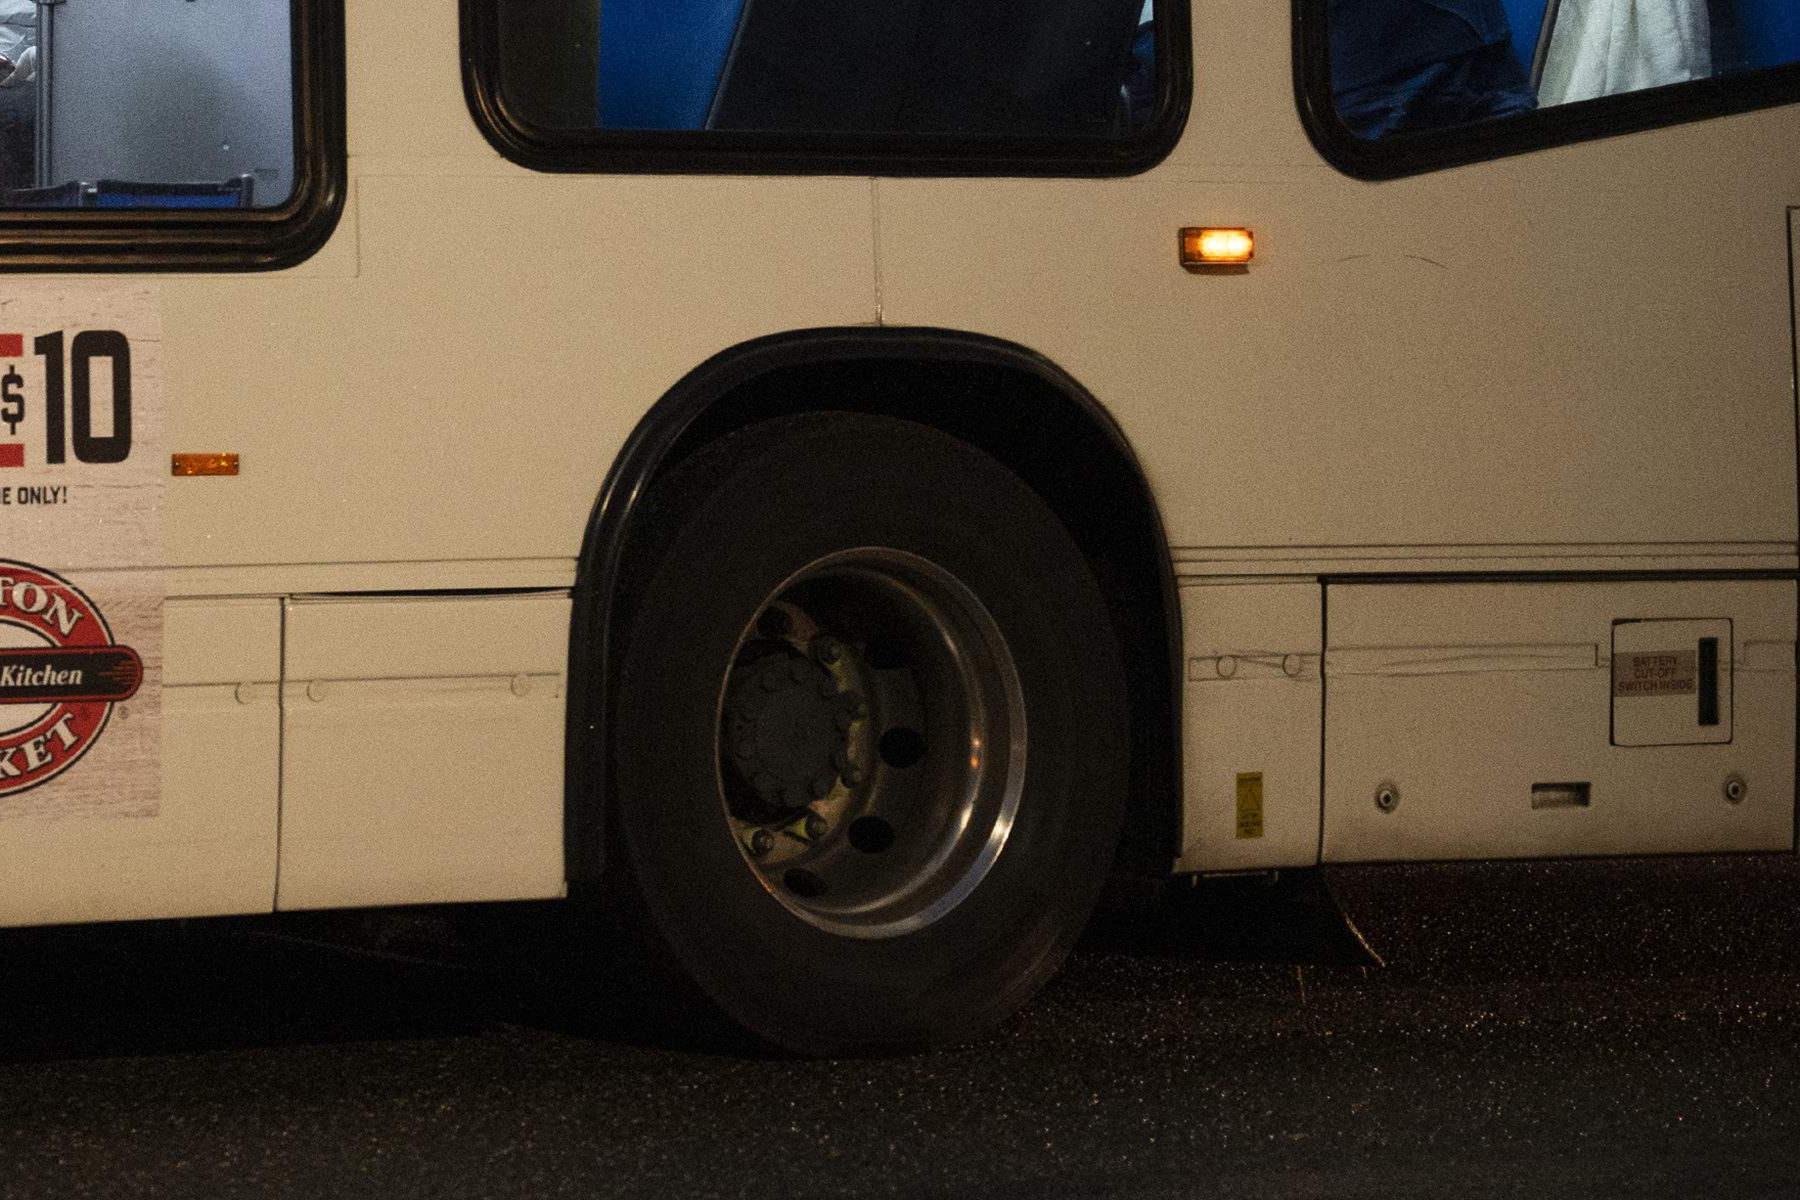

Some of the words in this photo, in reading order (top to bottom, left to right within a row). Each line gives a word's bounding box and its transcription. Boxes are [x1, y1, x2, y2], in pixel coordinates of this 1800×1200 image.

[17, 485, 68, 506] ONLY!
[1633, 655, 1677, 667] BATTERY
[0, 664, 83, 690] Kitchen
[1634, 667, 1677, 679] CUT-OFF
[1618, 680, 1657, 692] SWITCH
[1660, 678, 1693, 690] INSIDE
